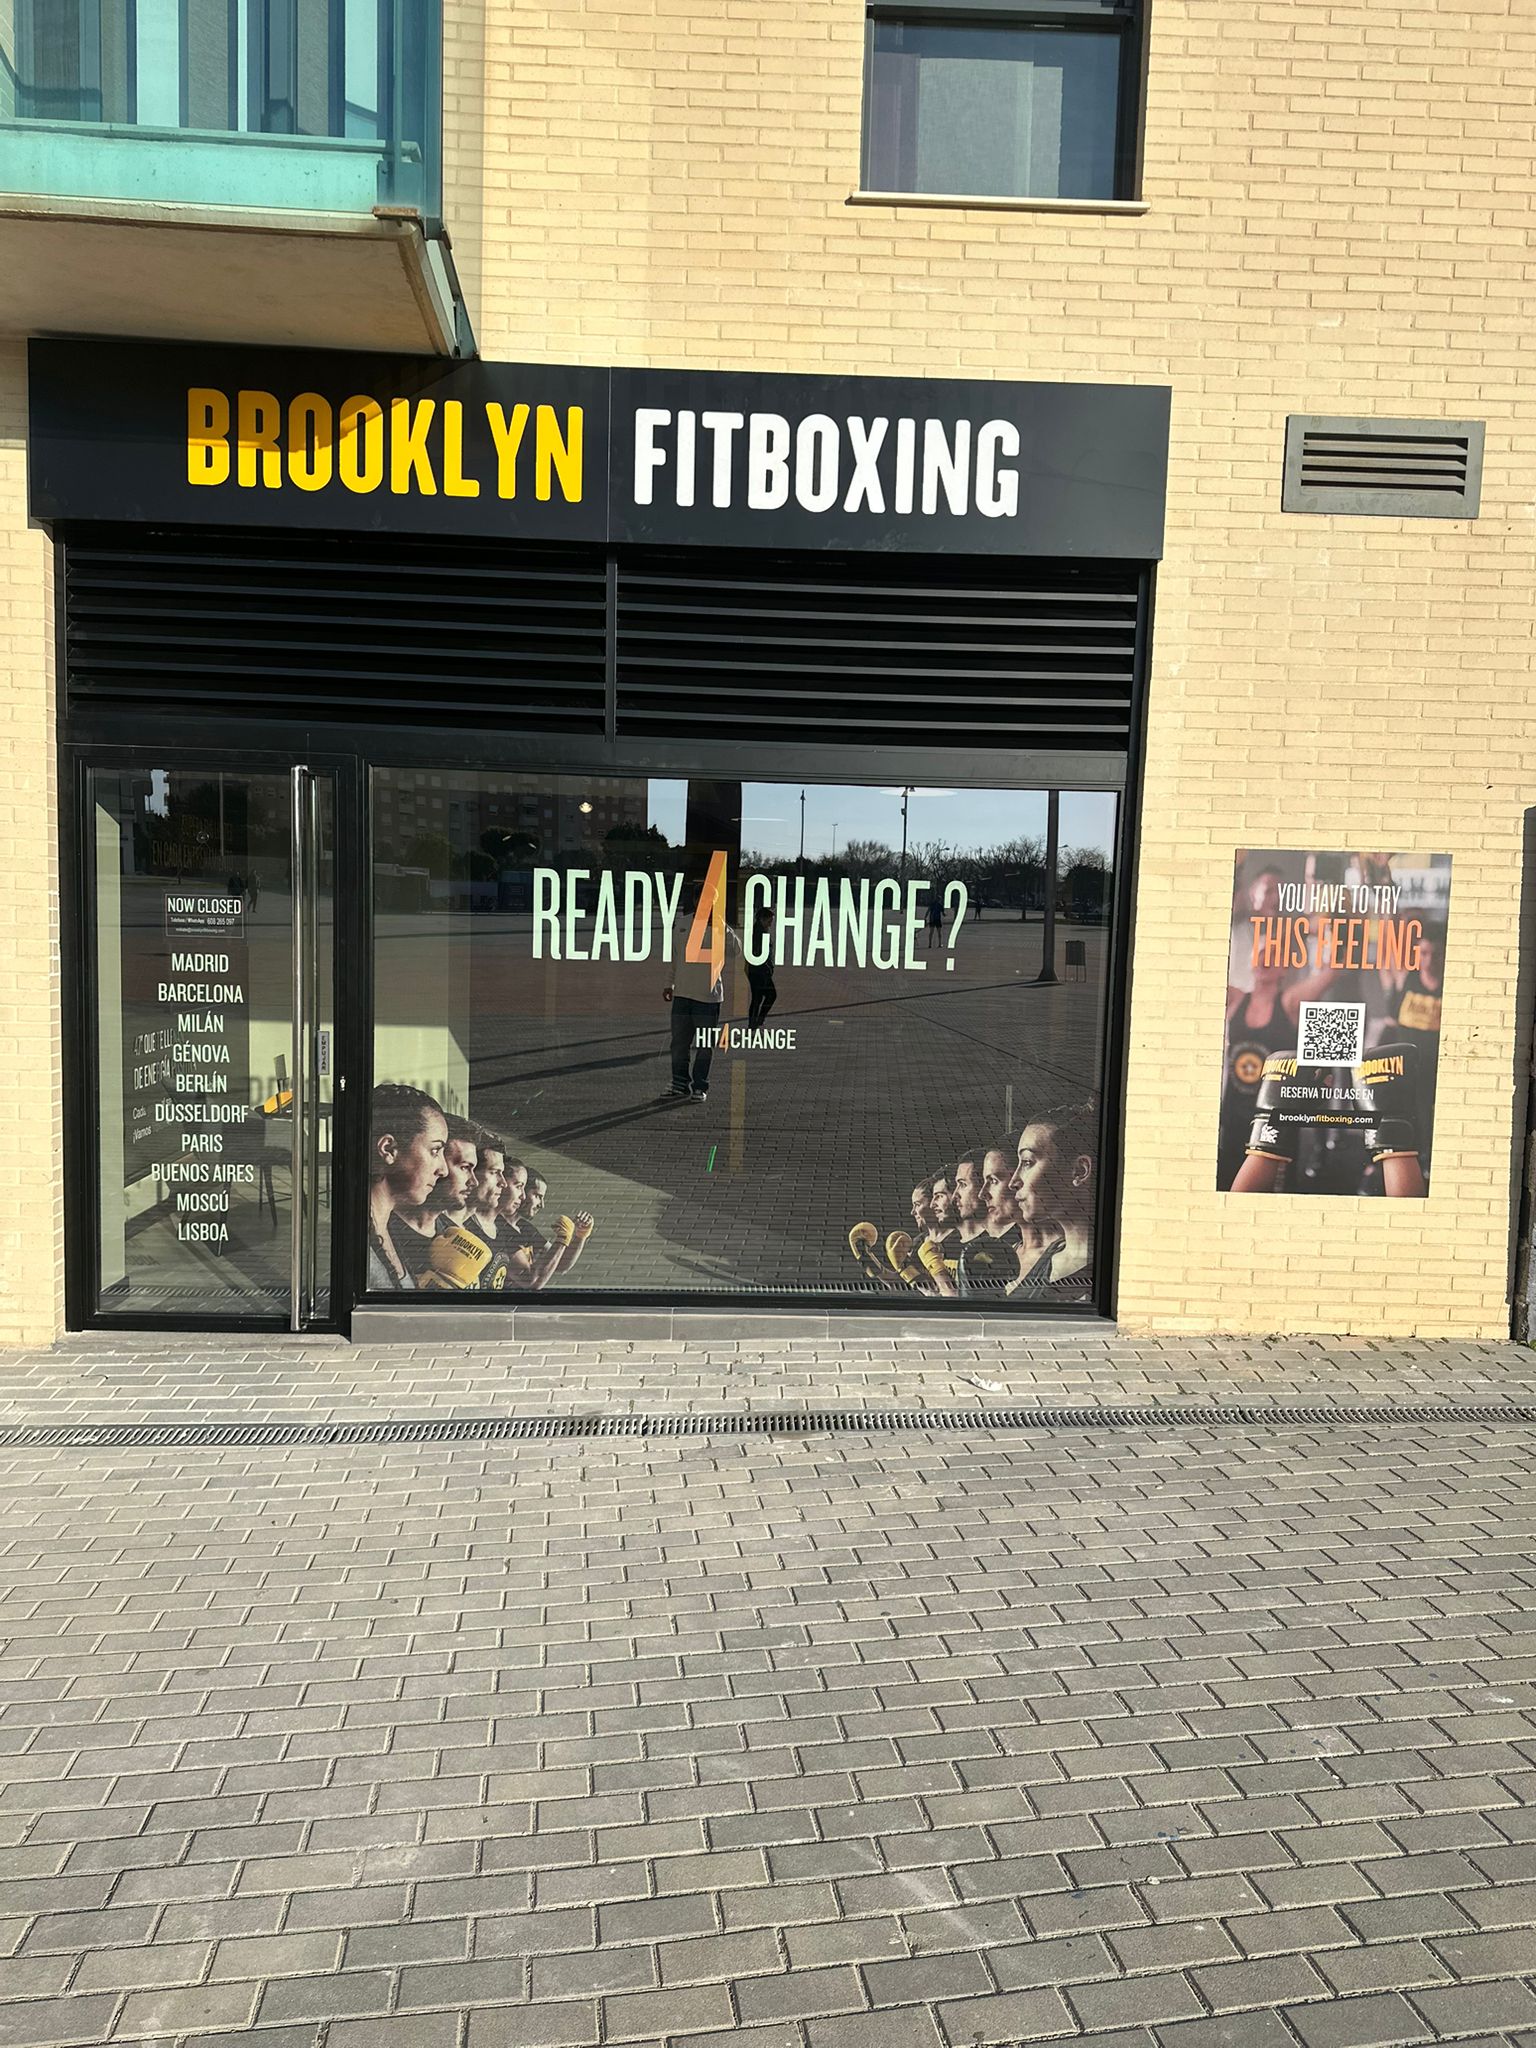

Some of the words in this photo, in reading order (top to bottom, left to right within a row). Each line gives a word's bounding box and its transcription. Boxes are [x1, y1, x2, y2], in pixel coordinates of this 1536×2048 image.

[187, 387, 583, 503] BROOKLYN
[633, 407, 1020, 518] FITBOXING
[167, 897, 195, 913] NOW
[197, 898, 242, 915] CLOSED
[1277, 882, 1307, 912] YOU
[1309, 883, 1349, 914] HAVE
[1351, 884, 1370, 914] TO
[1373, 885, 1402, 915] TRY
[532, 867, 684, 963] READY
[685, 850, 728, 991] 4
[744, 873, 931, 970] CHANGE
[1250, 916, 1310, 969] THIS
[1315, 917, 1423, 971] FEELING
[171, 952, 229, 973] MADRID
[158, 982, 244, 1004] BARCELONA
[177, 1010, 224, 1033] MILÁN
[172, 1039, 230, 1063] GÉNOVA
[176, 1070, 227, 1093] BERLÍN
[1280, 1086, 1319, 1099] RESERVA
[1321, 1087, 1333, 1099] TU
[1334, 1088, 1361, 1100] CLASE
[1362, 1088, 1375, 1101] EN
[1279, 1113, 1374, 1125] brooklynfitboxing.com
[181, 1133, 223, 1153] PARIS
[151, 1163, 209, 1183] BUENOS
[212, 1164, 254, 1183] AIRES
[176, 1189, 229, 1212] MOSCÚ
[178, 1222, 229, 1242] LISBOA
